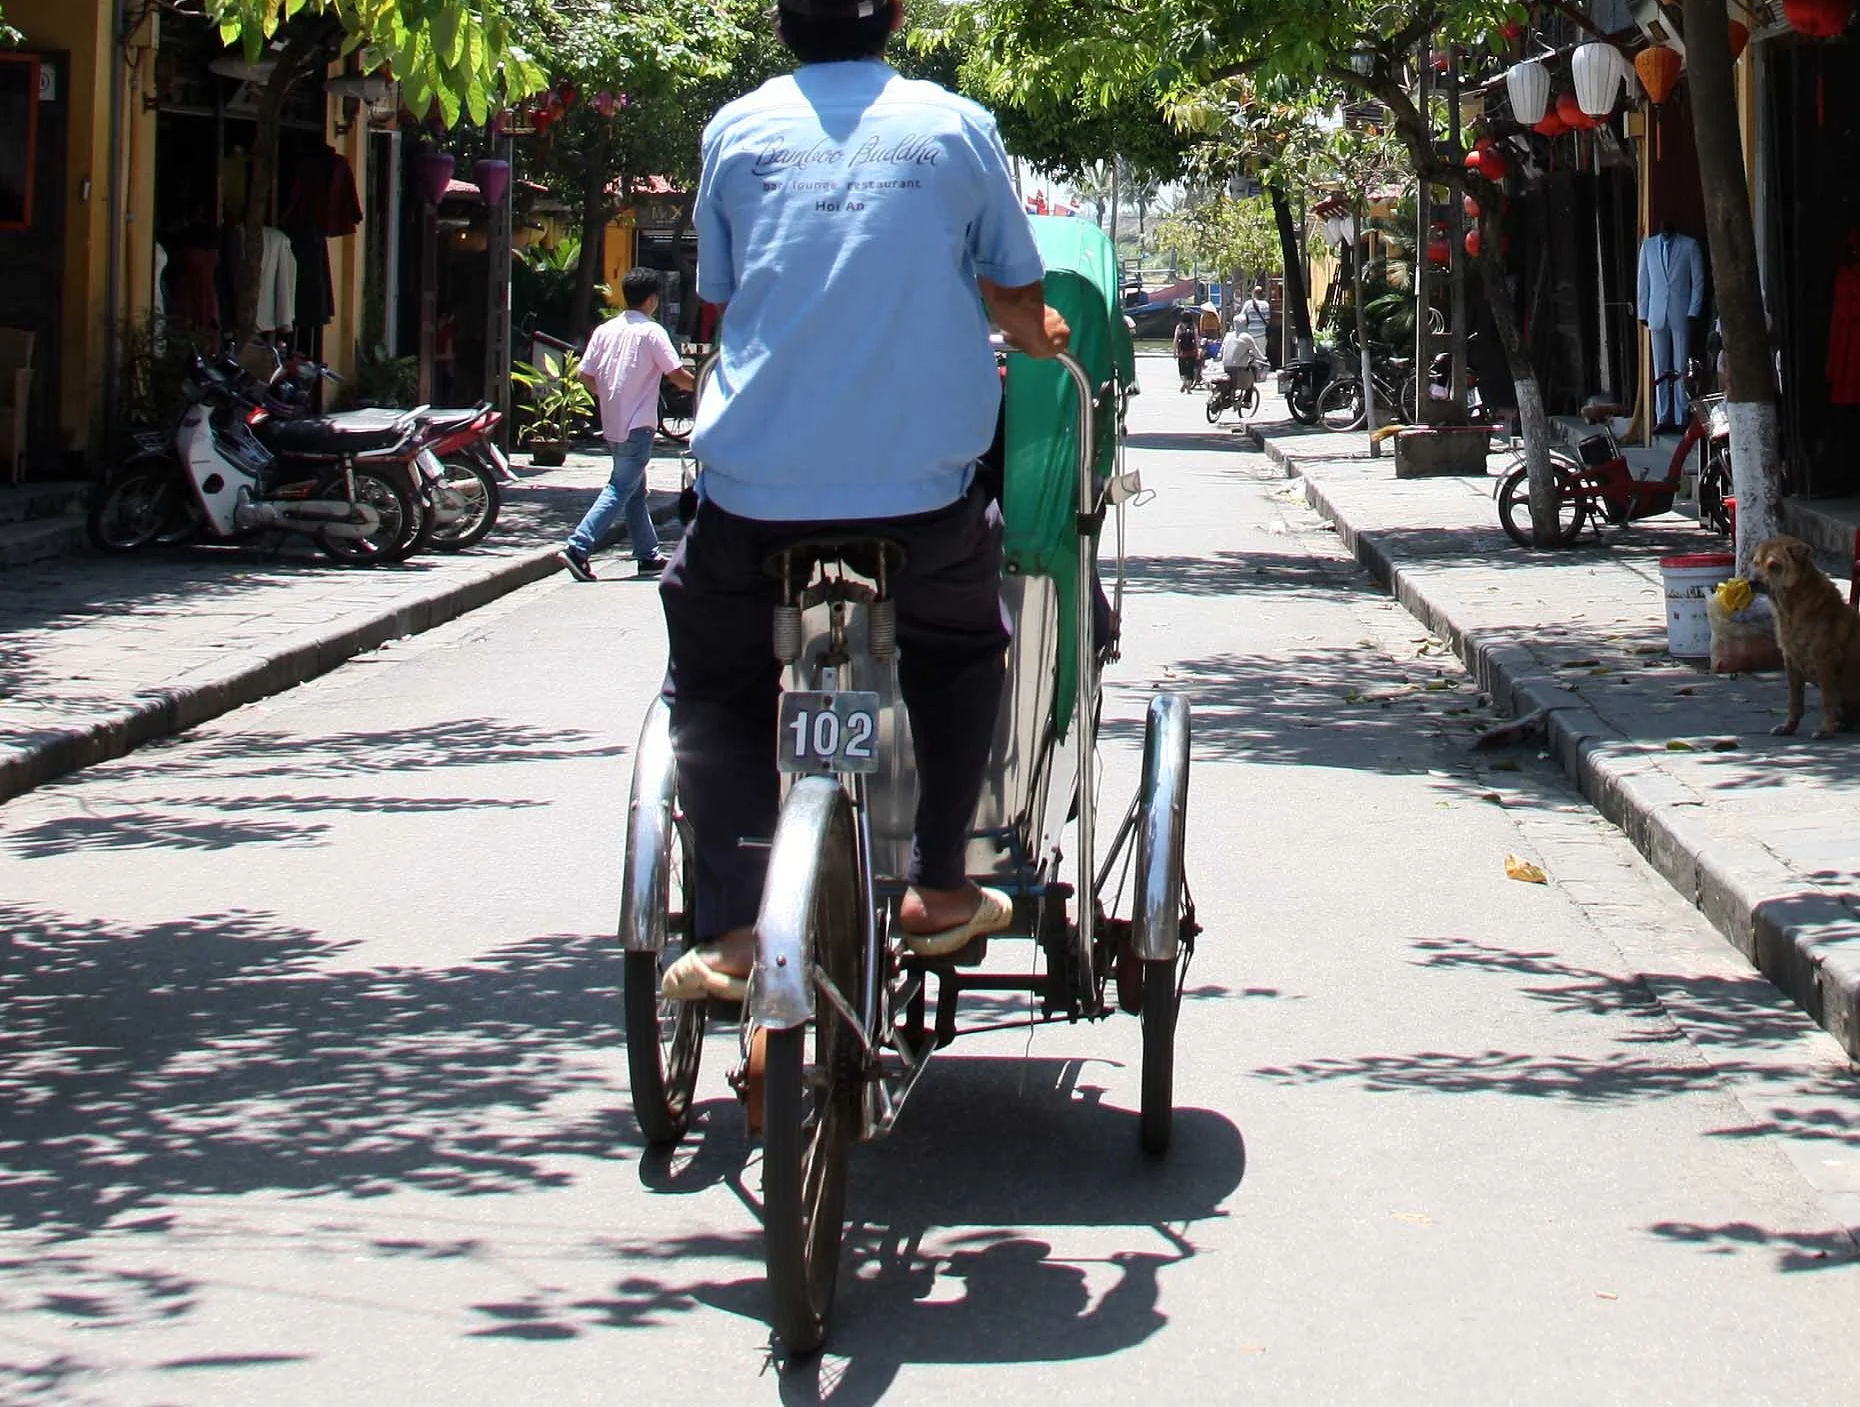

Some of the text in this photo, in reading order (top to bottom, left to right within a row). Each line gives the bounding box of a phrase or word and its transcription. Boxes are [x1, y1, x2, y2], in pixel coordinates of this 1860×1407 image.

[750, 134, 939, 176] Bamboo Buddha
[793, 180, 838, 192] lounge
[847, 179, 921, 190] restaurant
[815, 200, 865, 212] Hoi An
[789, 710, 873, 757] 102
